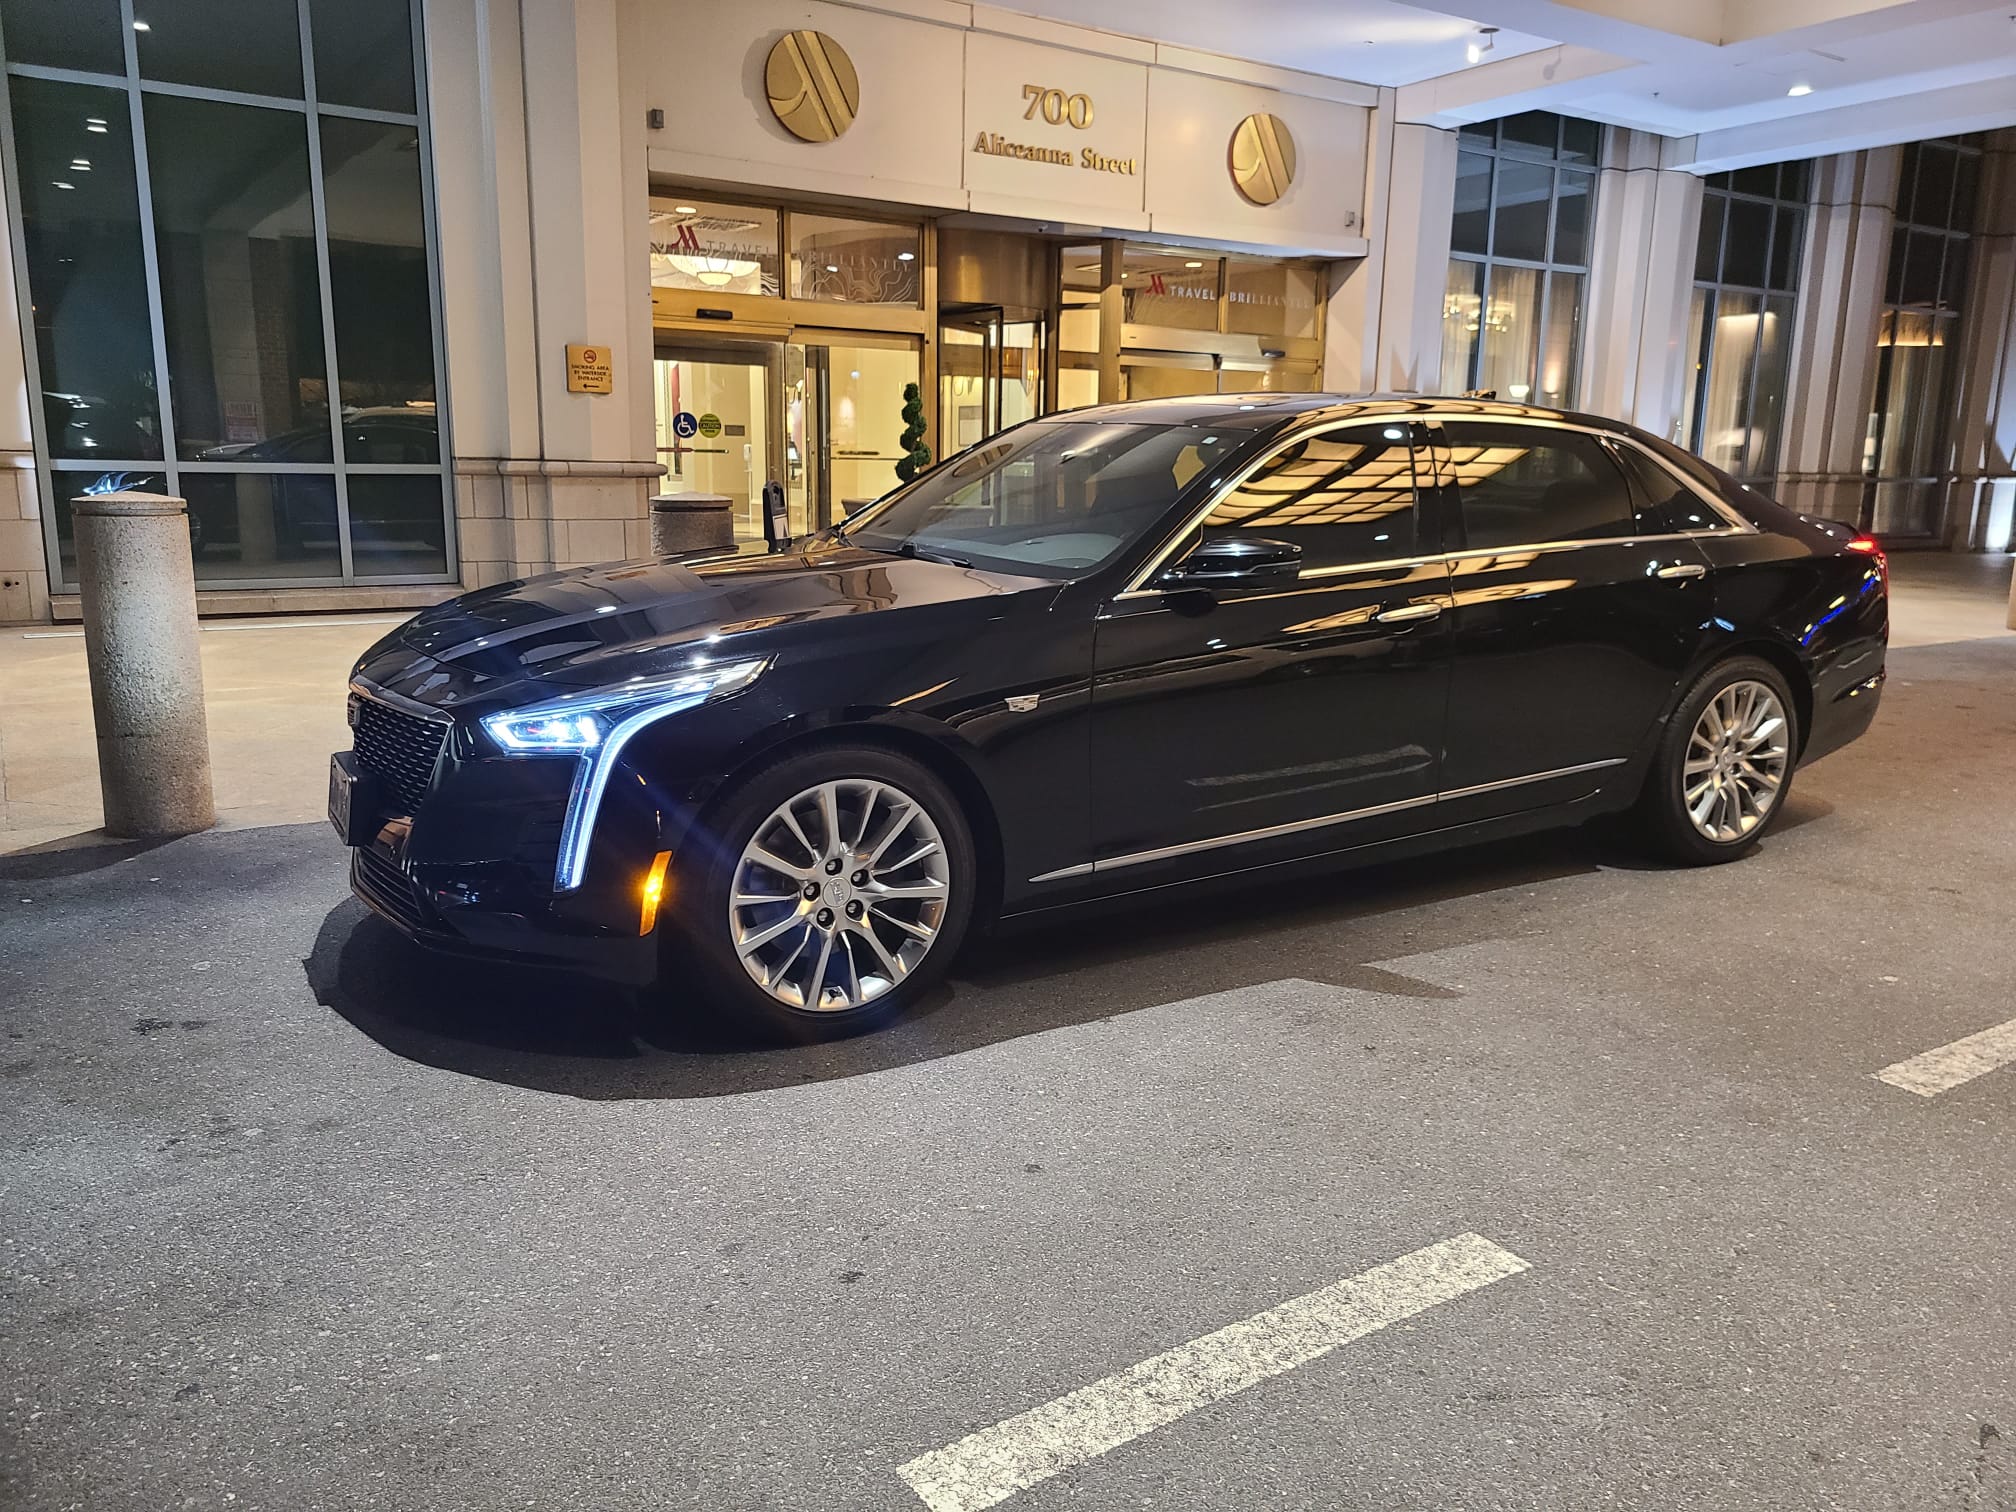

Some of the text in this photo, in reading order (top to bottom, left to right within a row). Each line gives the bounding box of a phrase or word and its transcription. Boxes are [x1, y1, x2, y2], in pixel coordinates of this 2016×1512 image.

[1022, 84, 1094, 129] 700
[972, 131, 1136, 175] Aliceanna Street
[706, 240, 776, 258] TRAVEL
[1170, 286, 1215, 300] TRAVEL
